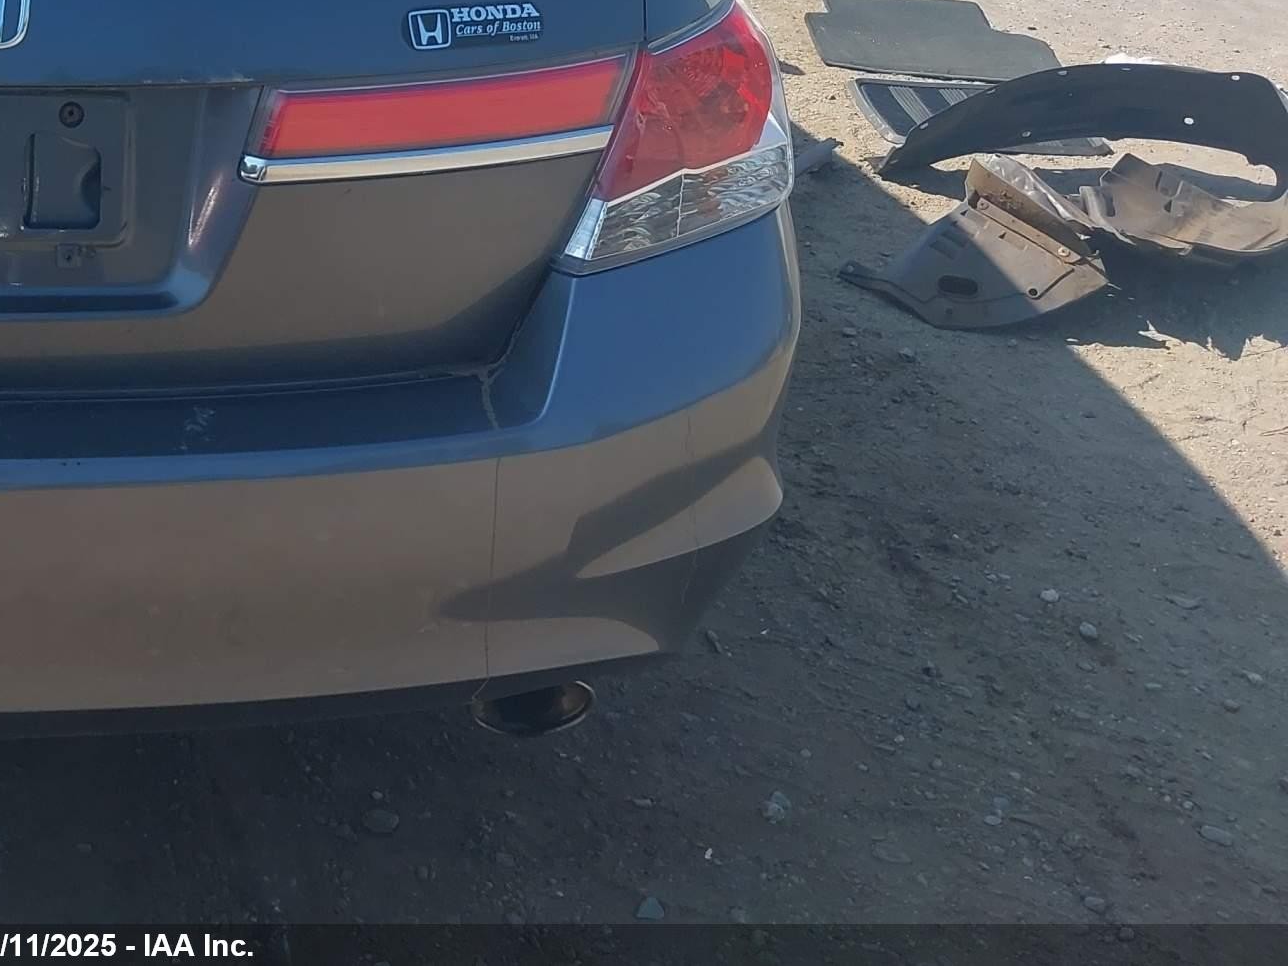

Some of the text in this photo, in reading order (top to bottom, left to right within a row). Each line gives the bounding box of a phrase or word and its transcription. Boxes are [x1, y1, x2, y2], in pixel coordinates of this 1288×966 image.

[450, 3, 540, 23] HONDA
[455, 20, 541, 36] Cars of Boston
